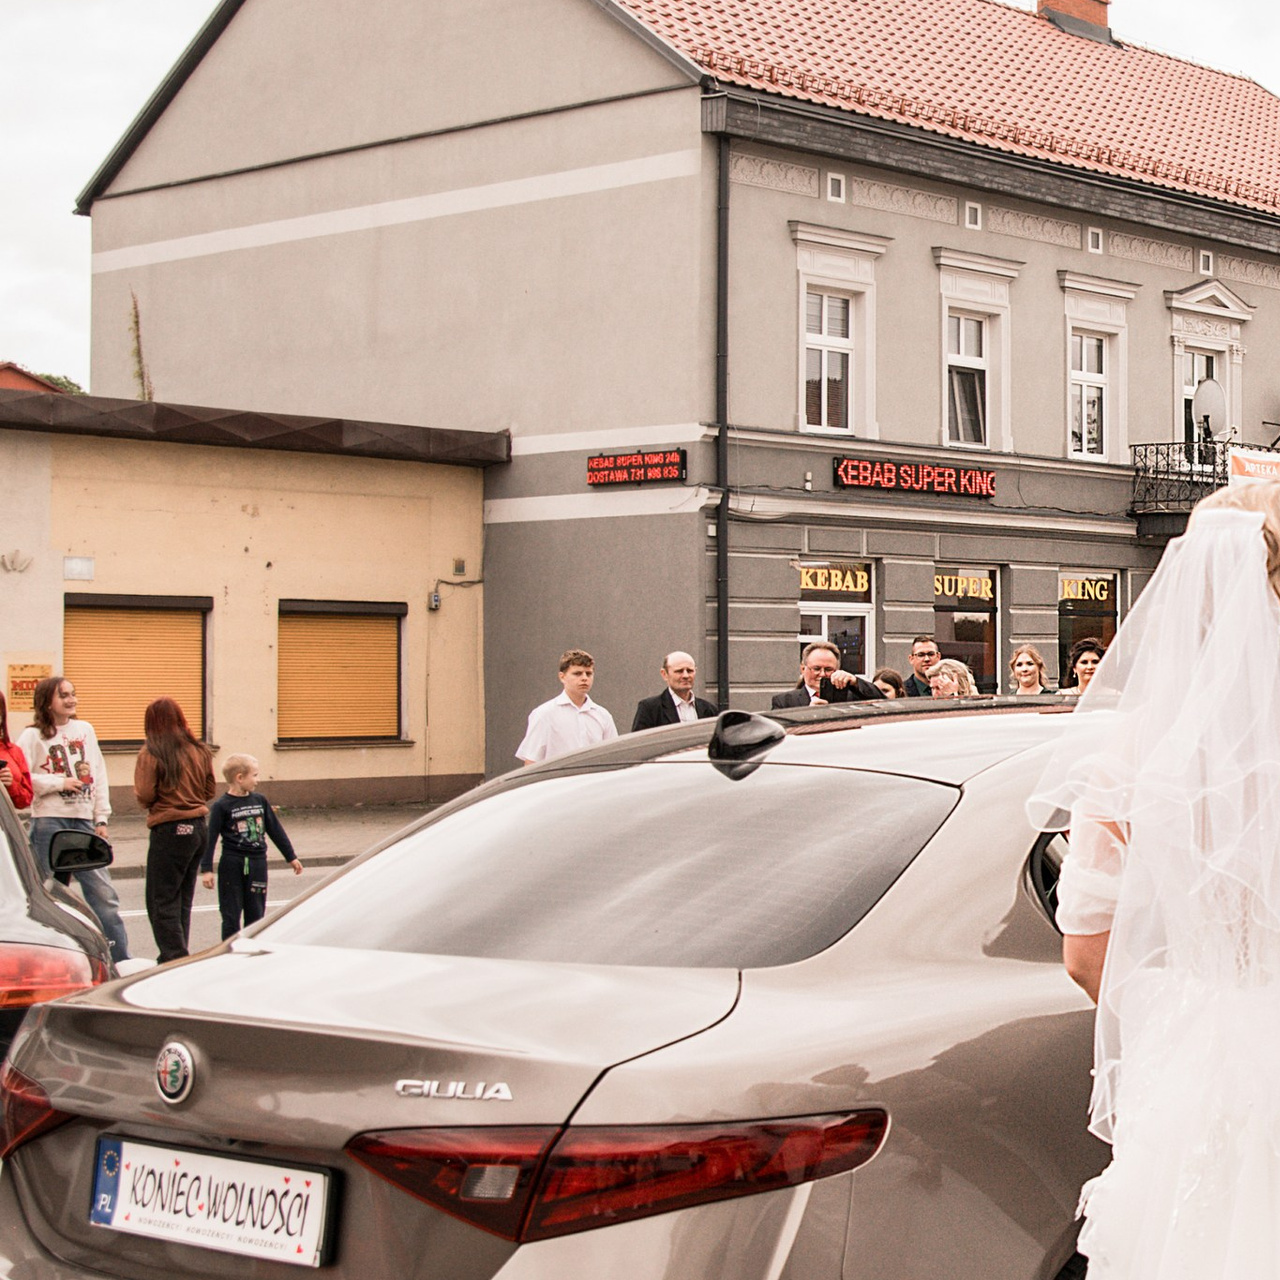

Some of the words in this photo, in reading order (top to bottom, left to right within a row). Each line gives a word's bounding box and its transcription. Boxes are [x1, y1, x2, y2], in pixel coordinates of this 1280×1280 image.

[616, 454, 643, 467] SUPER
[1244, 462, 1278, 476] APTEKA
[587, 469, 629, 483] DOSTAWA
[900, 464, 958, 493] SUPER
[800, 568, 869, 592] KEBAB
[934, 574, 993, 599] SUPER
[1061, 579, 1109, 601] KING
[395, 1079, 513, 1100] GIULIA
[130, 1164, 201, 1218] KONIEC
[99, 1193, 112, 1213] PL
